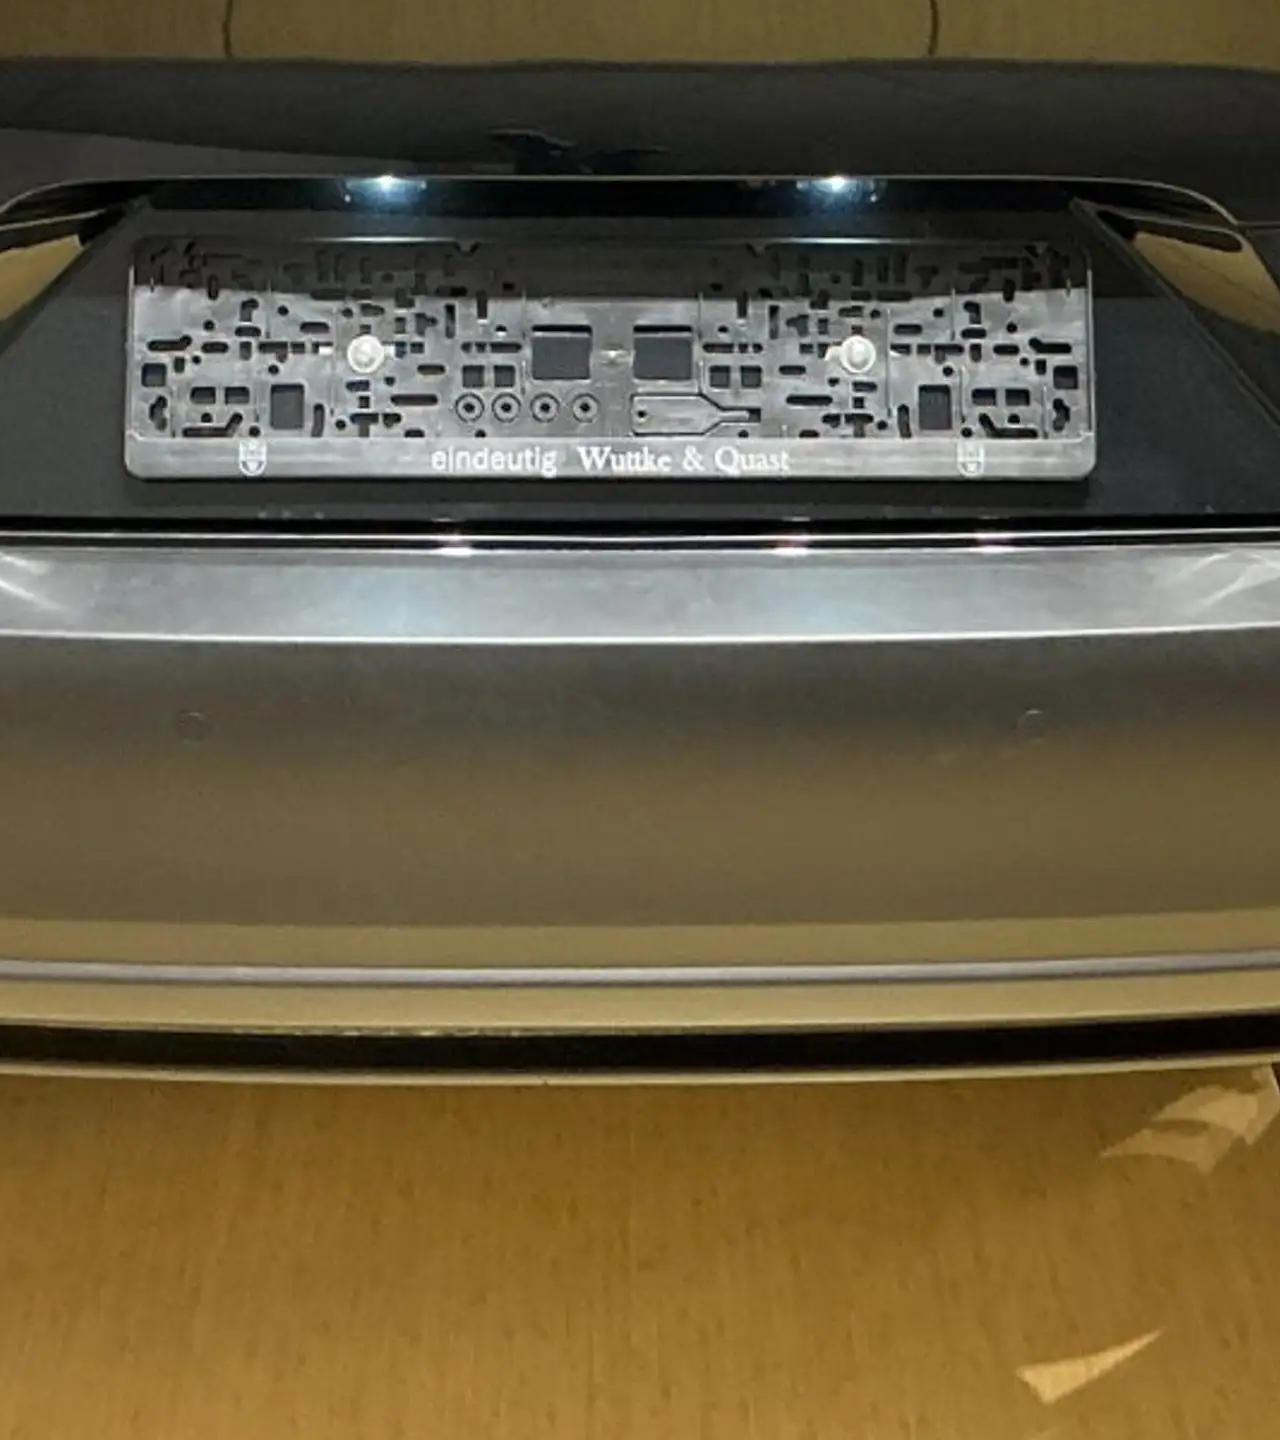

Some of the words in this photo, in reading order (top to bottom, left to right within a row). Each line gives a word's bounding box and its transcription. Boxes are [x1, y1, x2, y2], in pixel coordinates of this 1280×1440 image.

[430, 445, 558, 478] eindeutig
[575, 445, 673, 472] Wuttke
[681, 444, 706, 473] &
[714, 445, 792, 475] Quast
